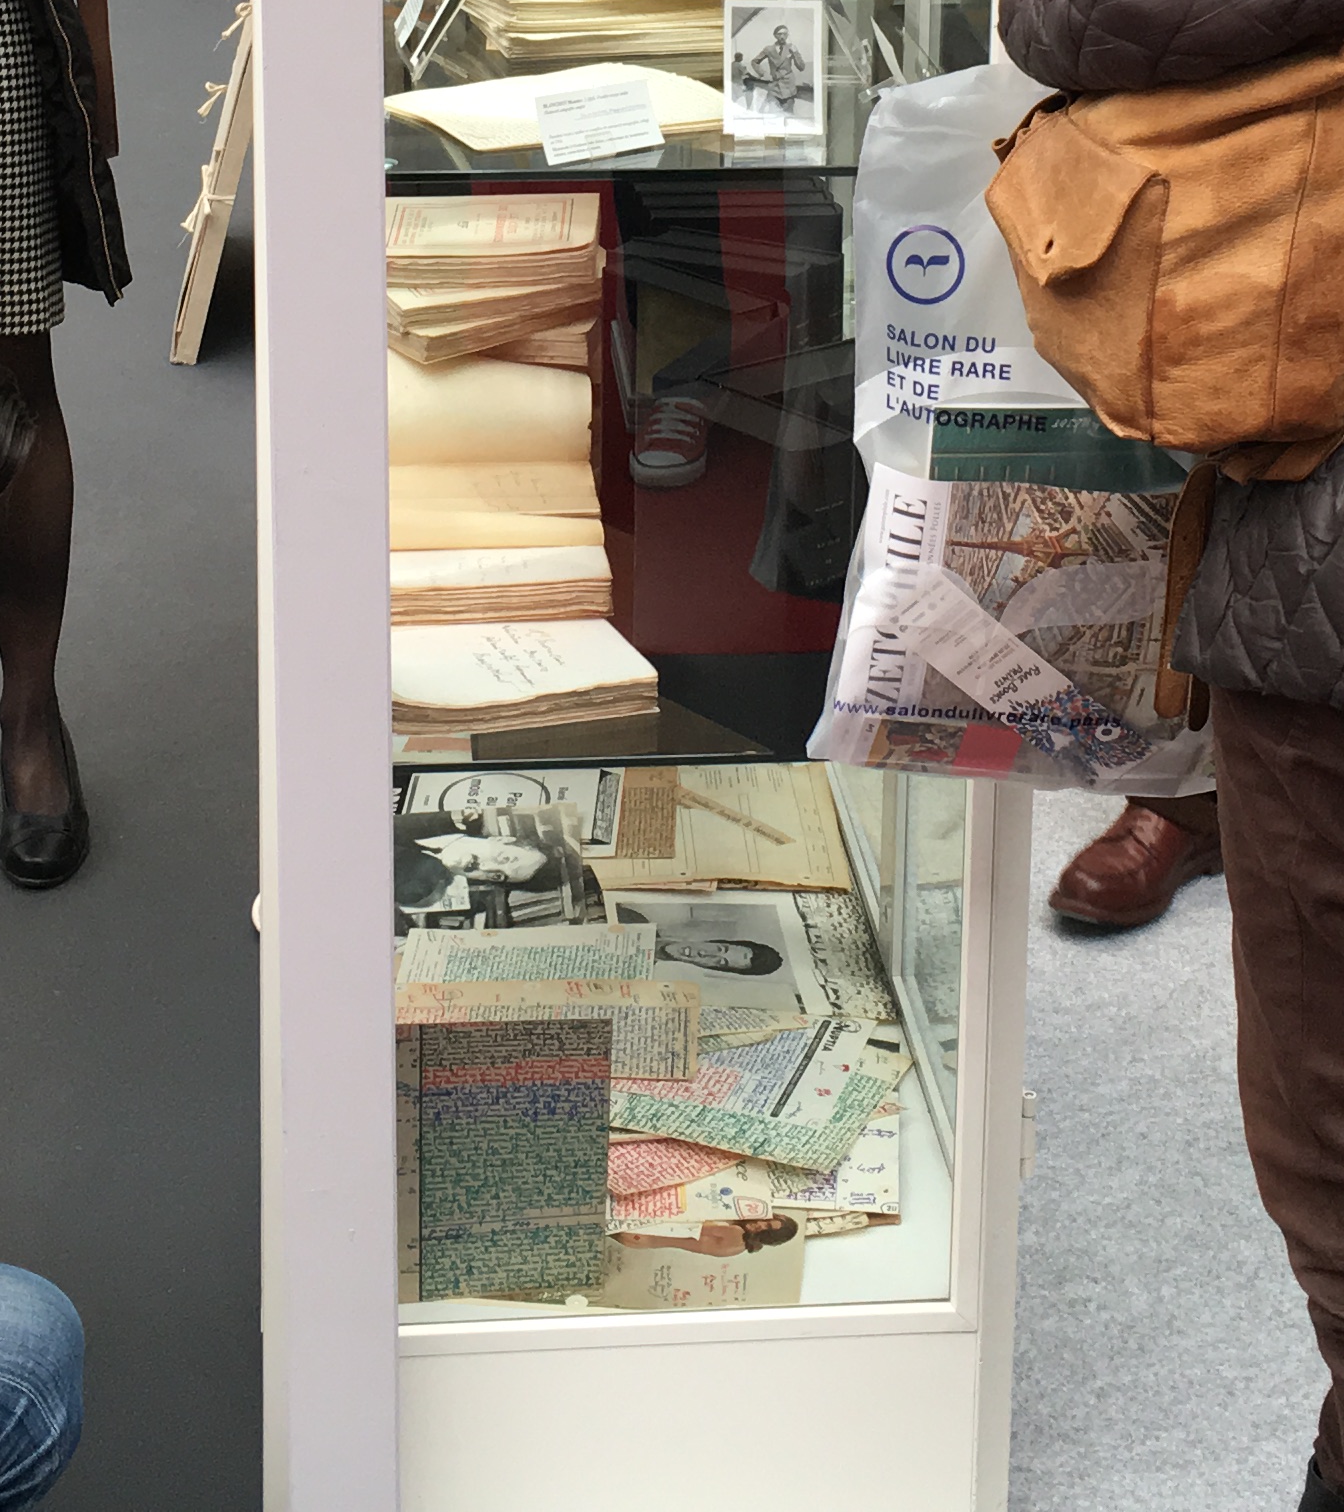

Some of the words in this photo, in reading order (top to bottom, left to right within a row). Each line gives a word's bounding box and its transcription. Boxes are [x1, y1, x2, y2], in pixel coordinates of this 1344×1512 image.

[886, 324, 956, 352] SALON
[965, 336, 996, 353] DU
[886, 347, 941, 375] LIVRE
[950, 360, 1012, 380] RARE
[887, 371, 906, 390] ET
[913, 381, 940, 400] DE
[886, 393, 1048, 432] L'AUTOGRAPHE
